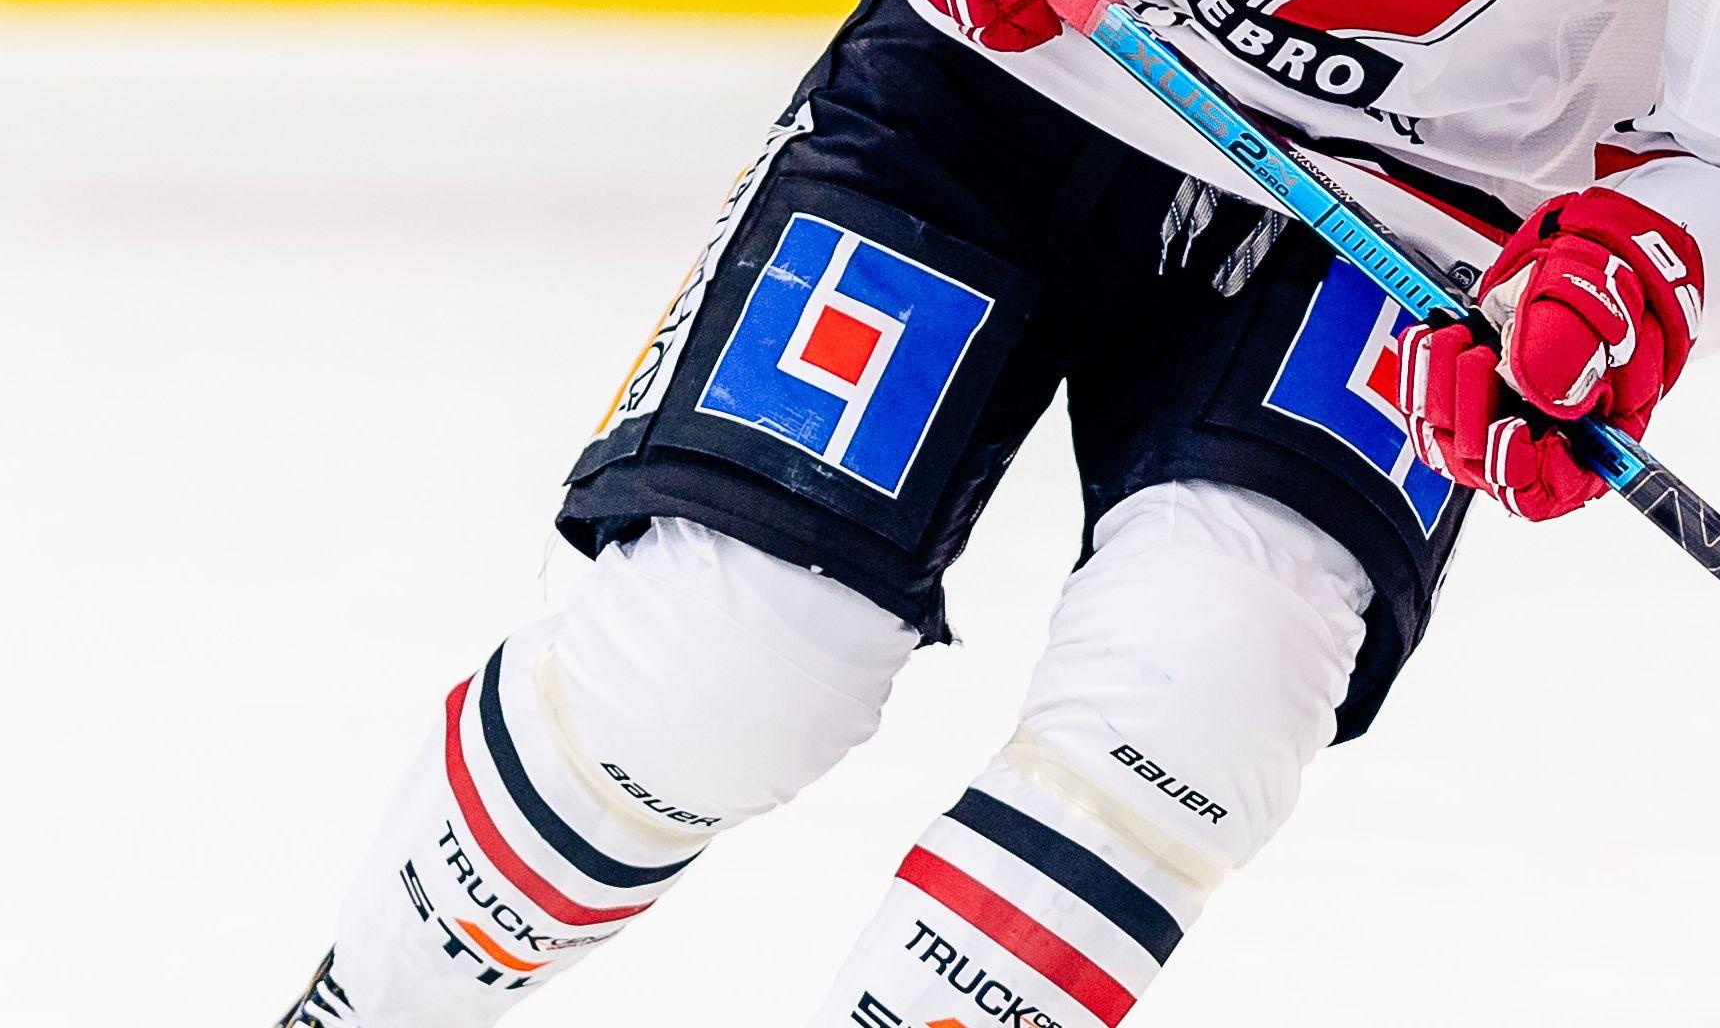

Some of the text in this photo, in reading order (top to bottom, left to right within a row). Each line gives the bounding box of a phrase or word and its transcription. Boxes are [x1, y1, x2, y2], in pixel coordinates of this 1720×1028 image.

[1098, 12, 1240, 140] EXUS
[1254, 164, 1290, 198] PRO
[599, 761, 723, 828] BAUER
[1110, 744, 1229, 824] BAUER
[438, 819, 552, 952] TRUCK
[904, 918, 1040, 1028] TRUCK
